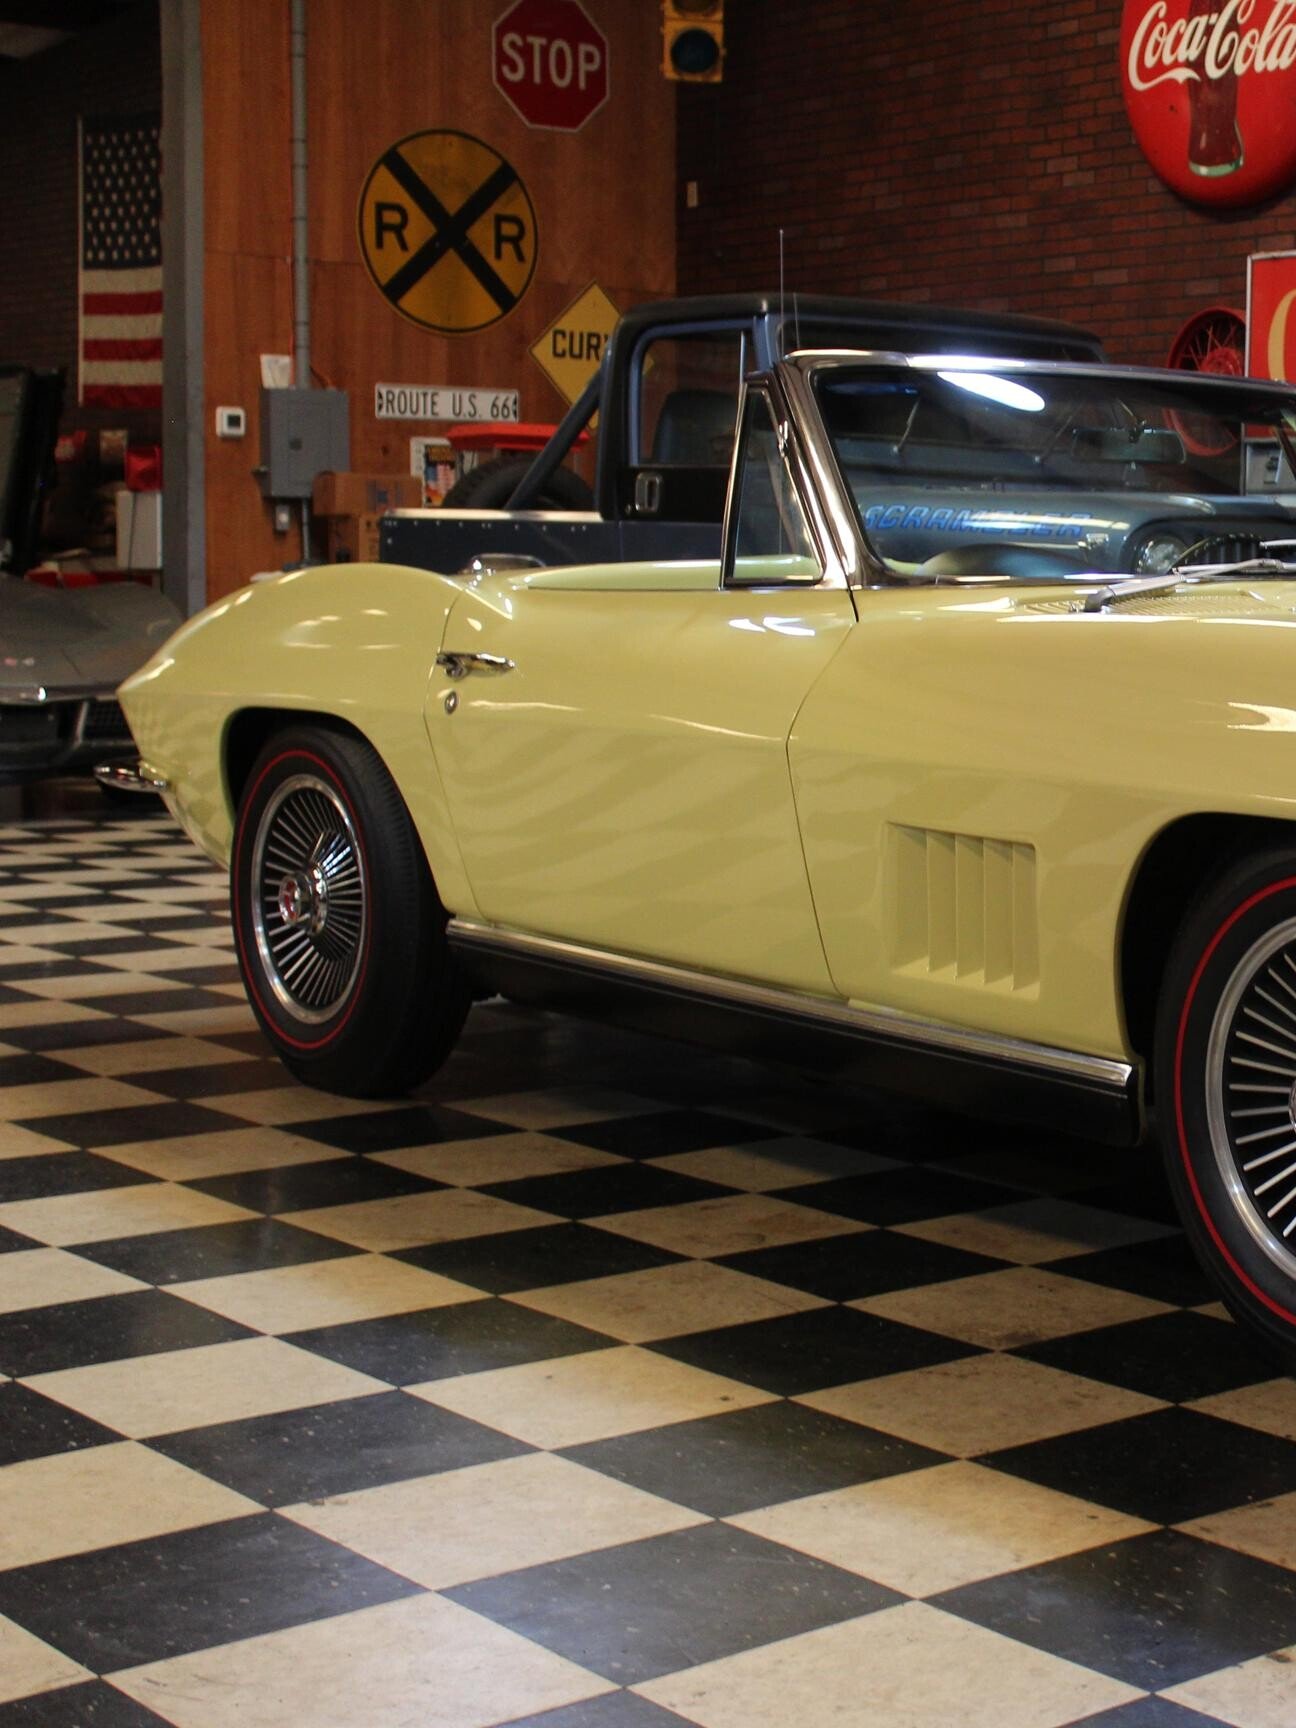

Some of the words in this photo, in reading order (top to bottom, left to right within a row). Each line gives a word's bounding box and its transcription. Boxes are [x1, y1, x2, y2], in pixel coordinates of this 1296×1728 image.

[501, 32, 601, 91] STOP
[374, 202, 409, 252] R
[493, 213, 526, 263] R
[552, 329, 608, 361] CUR
[385, 390, 439, 416] ROUTE
[452, 392, 482, 418] U.S.
[490, 396, 511, 419] 66
